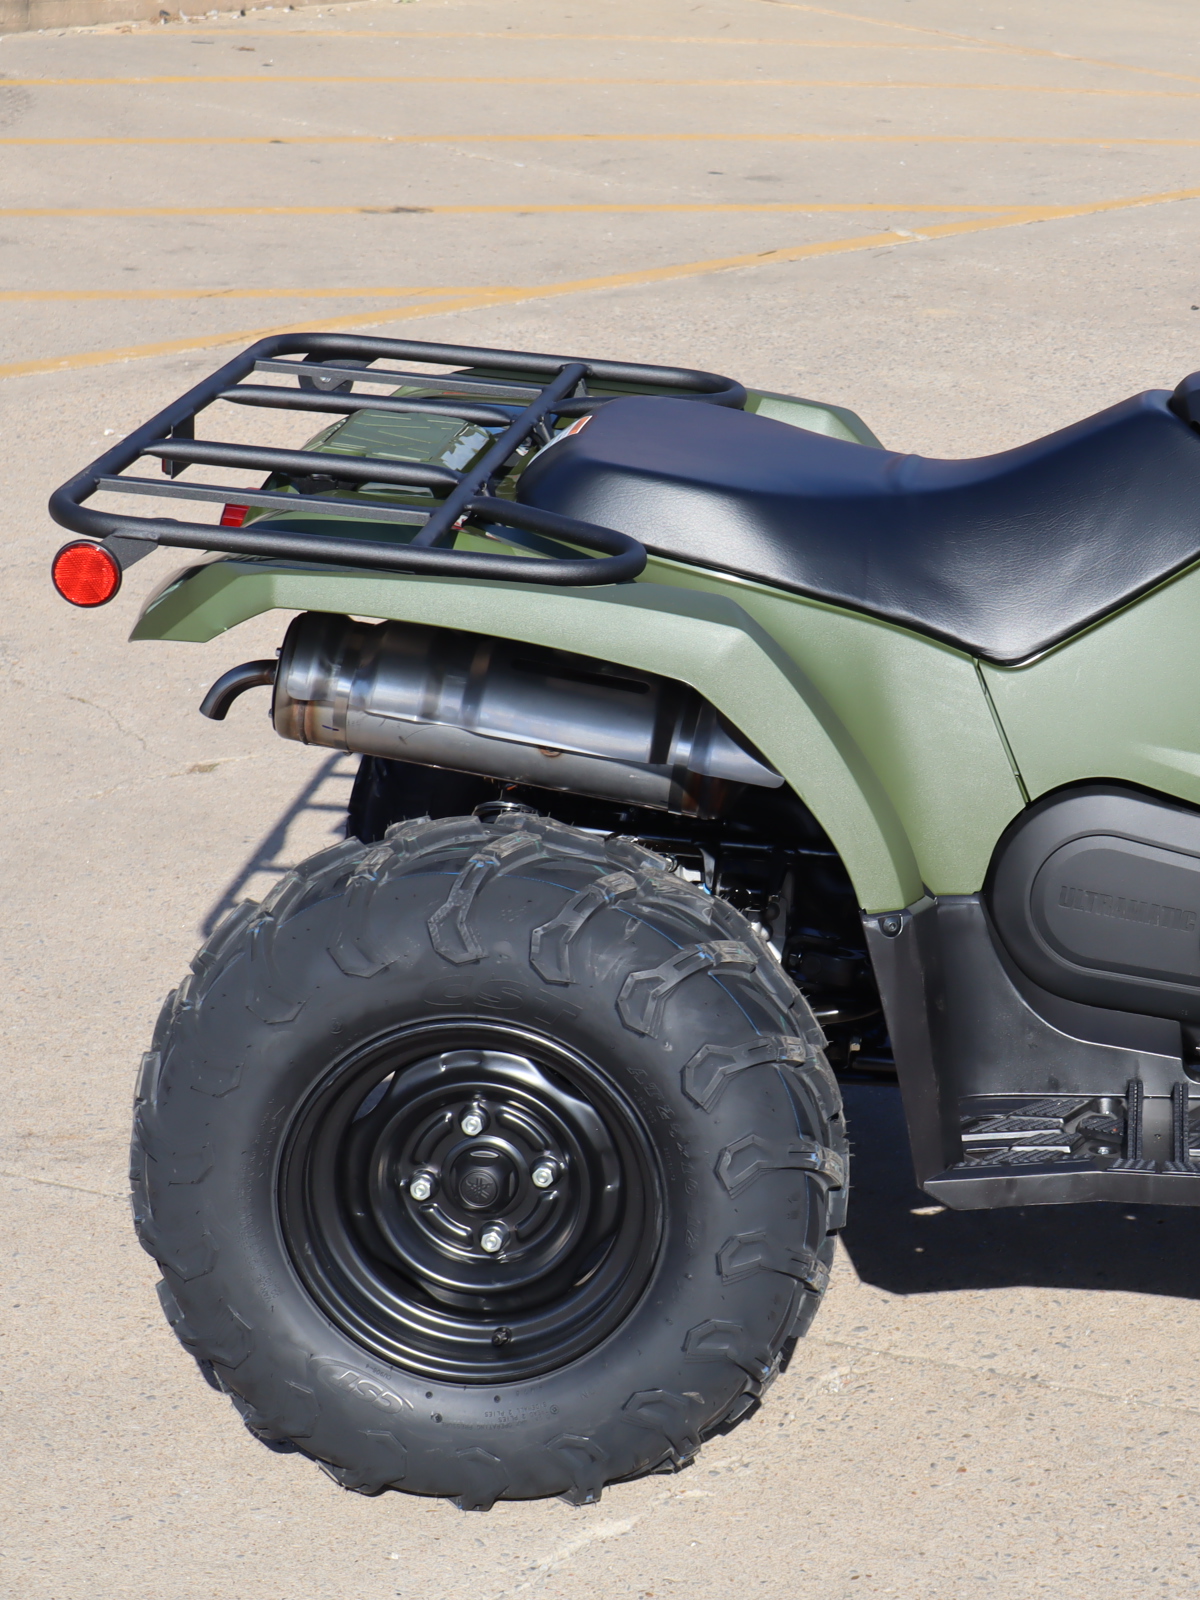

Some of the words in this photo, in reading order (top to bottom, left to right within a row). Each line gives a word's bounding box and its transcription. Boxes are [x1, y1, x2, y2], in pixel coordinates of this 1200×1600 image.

[1058, 885, 1197, 932] ULTRAMATIC
[420, 974, 583, 1025] CST
[332, 1369, 403, 1414] CST
